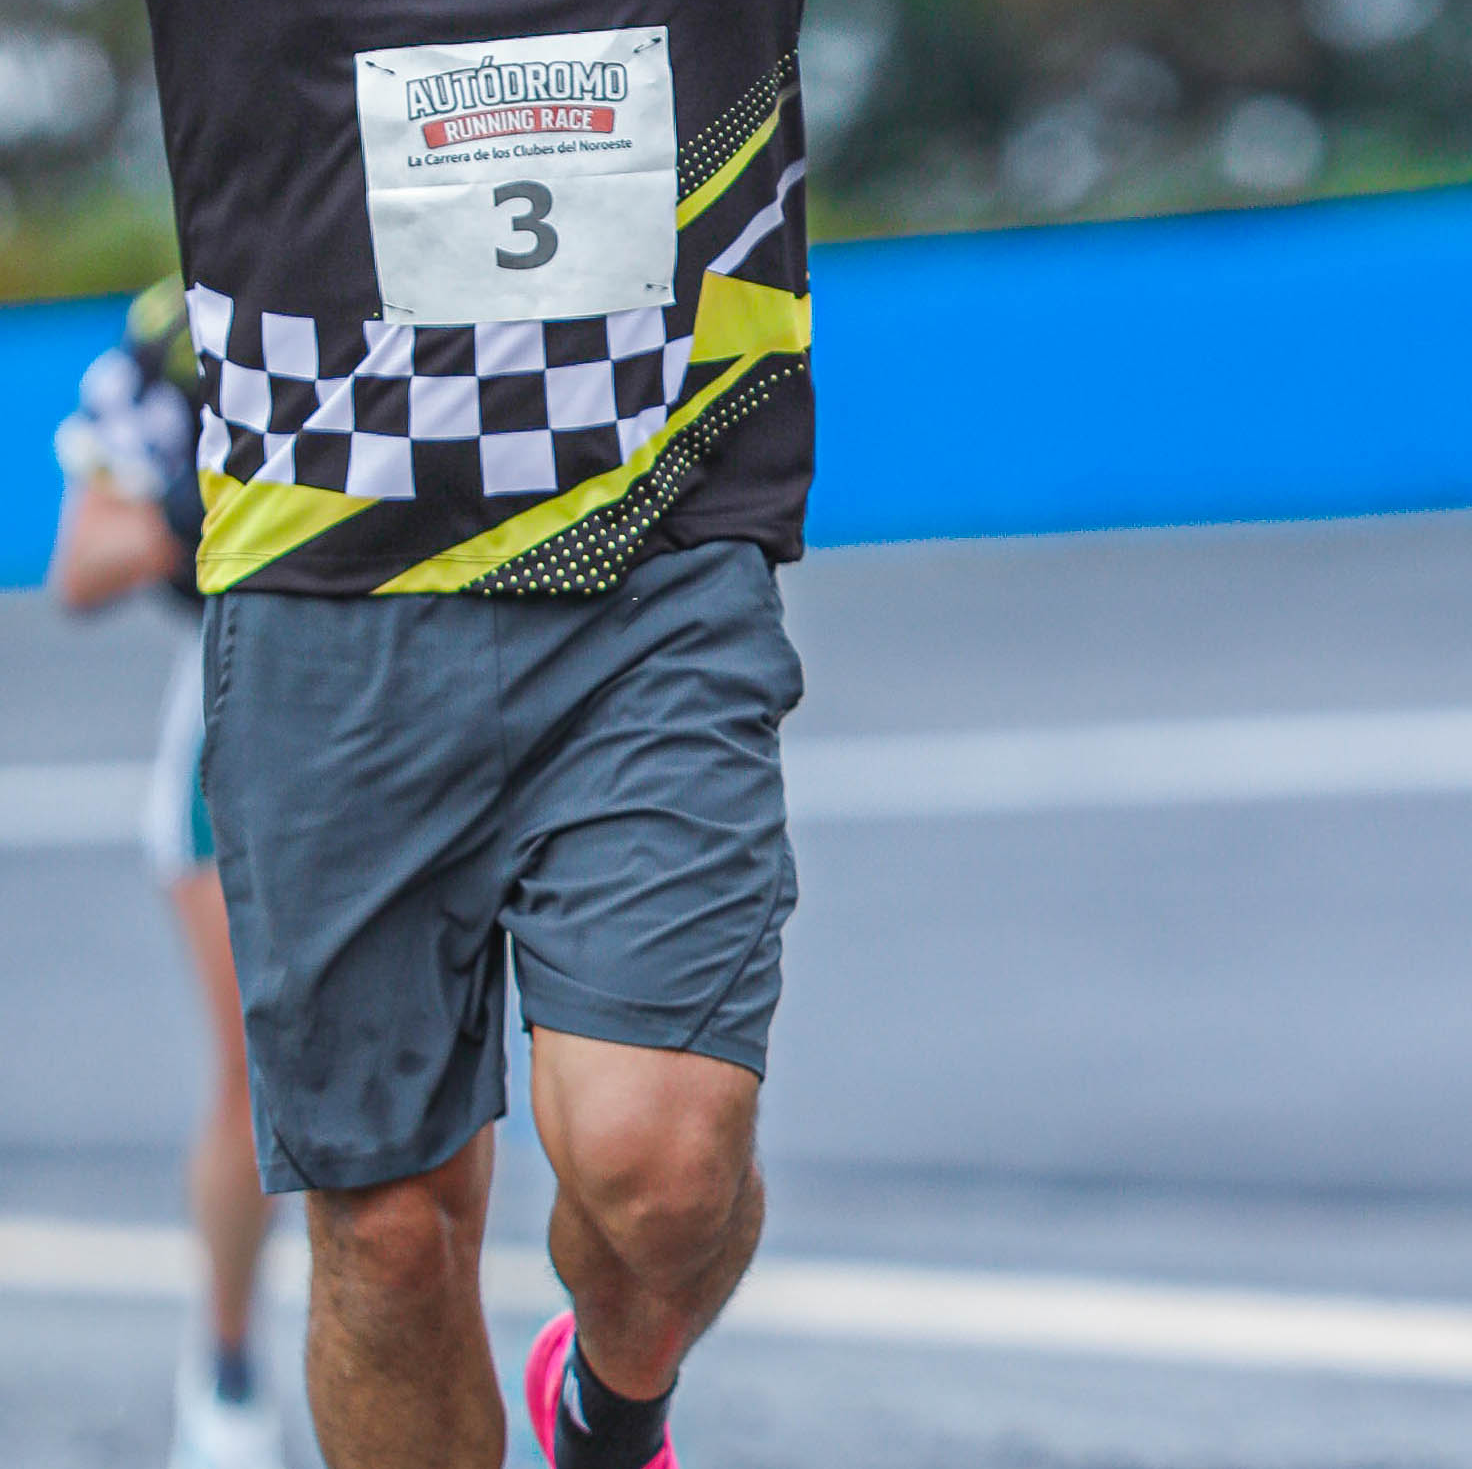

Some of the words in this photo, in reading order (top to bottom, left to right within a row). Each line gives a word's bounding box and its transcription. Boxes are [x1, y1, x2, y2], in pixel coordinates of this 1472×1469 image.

[406, 55, 627, 120] AUTÓDROMO
[444, 109, 534, 142] RUNNING
[540, 107, 593, 130] RACE
[408, 155, 422, 167] La
[425, 150, 470, 165] Carrera
[474, 148, 489, 160] de
[493, 147, 510, 159] los
[513, 143, 554, 158] Clubes
[559, 141, 576, 153] del
[580, 138, 633, 152] Noroeste
[493, 180, 558, 269] 3
